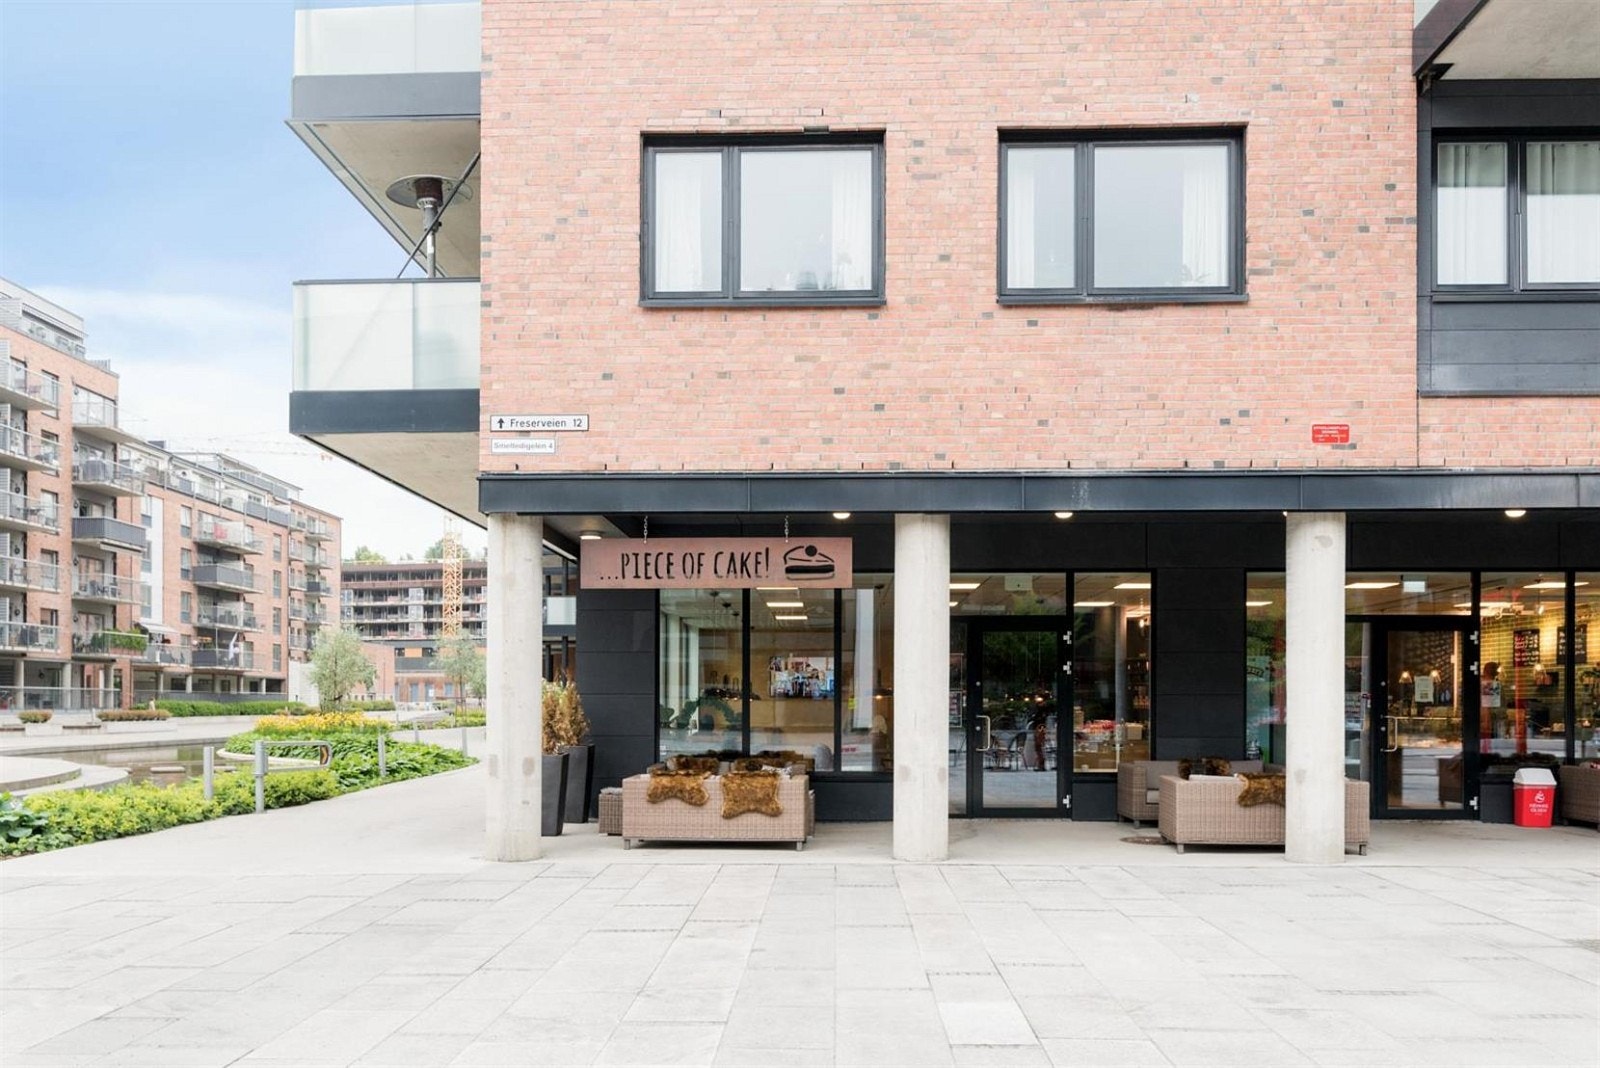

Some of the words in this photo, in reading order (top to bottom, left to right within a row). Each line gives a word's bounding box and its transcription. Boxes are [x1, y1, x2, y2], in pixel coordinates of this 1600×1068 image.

[510, 418, 567, 427] Freserveien
[573, 418, 582, 427] 12
[682, 551, 706, 580] OF
[713, 546, 770, 580] CAKE!
